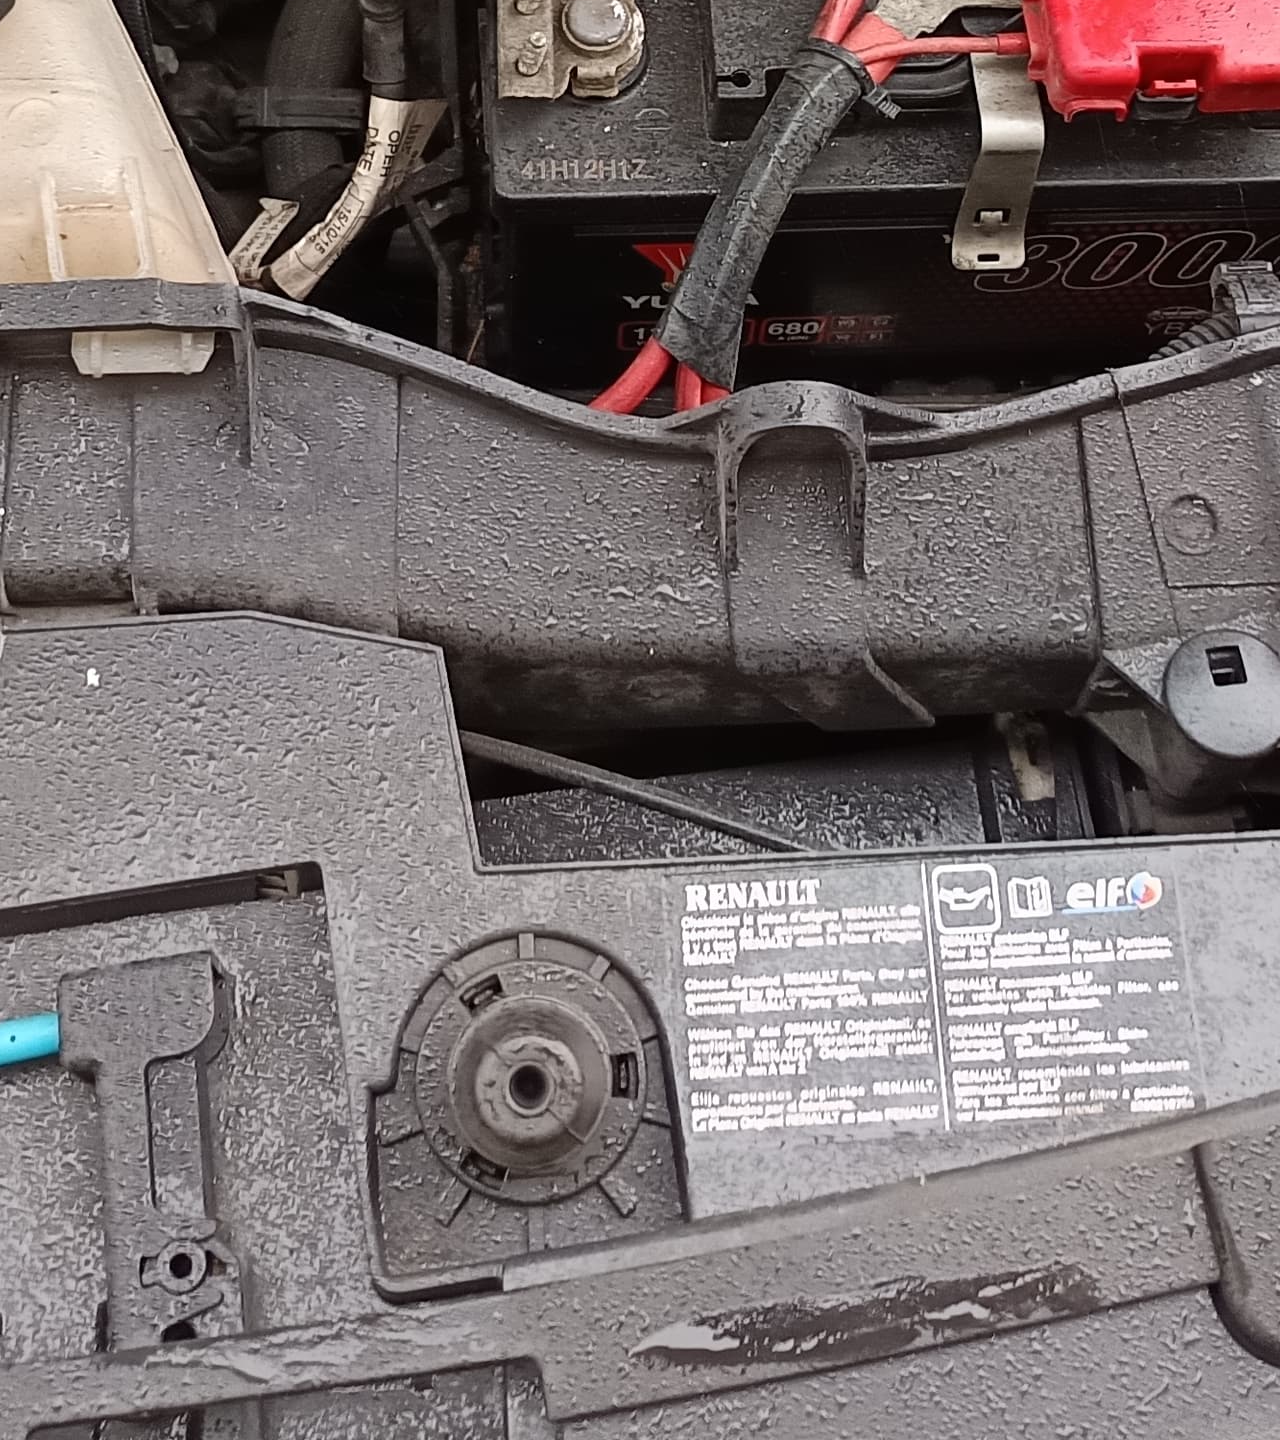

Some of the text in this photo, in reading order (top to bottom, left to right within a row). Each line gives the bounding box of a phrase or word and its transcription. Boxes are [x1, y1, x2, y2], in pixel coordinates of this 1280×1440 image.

[358, 126, 380, 172] DATE
[768, 321, 820, 335] 680
[685, 879, 819, 911] RENAULT
[1066, 877, 1126, 908] elf
